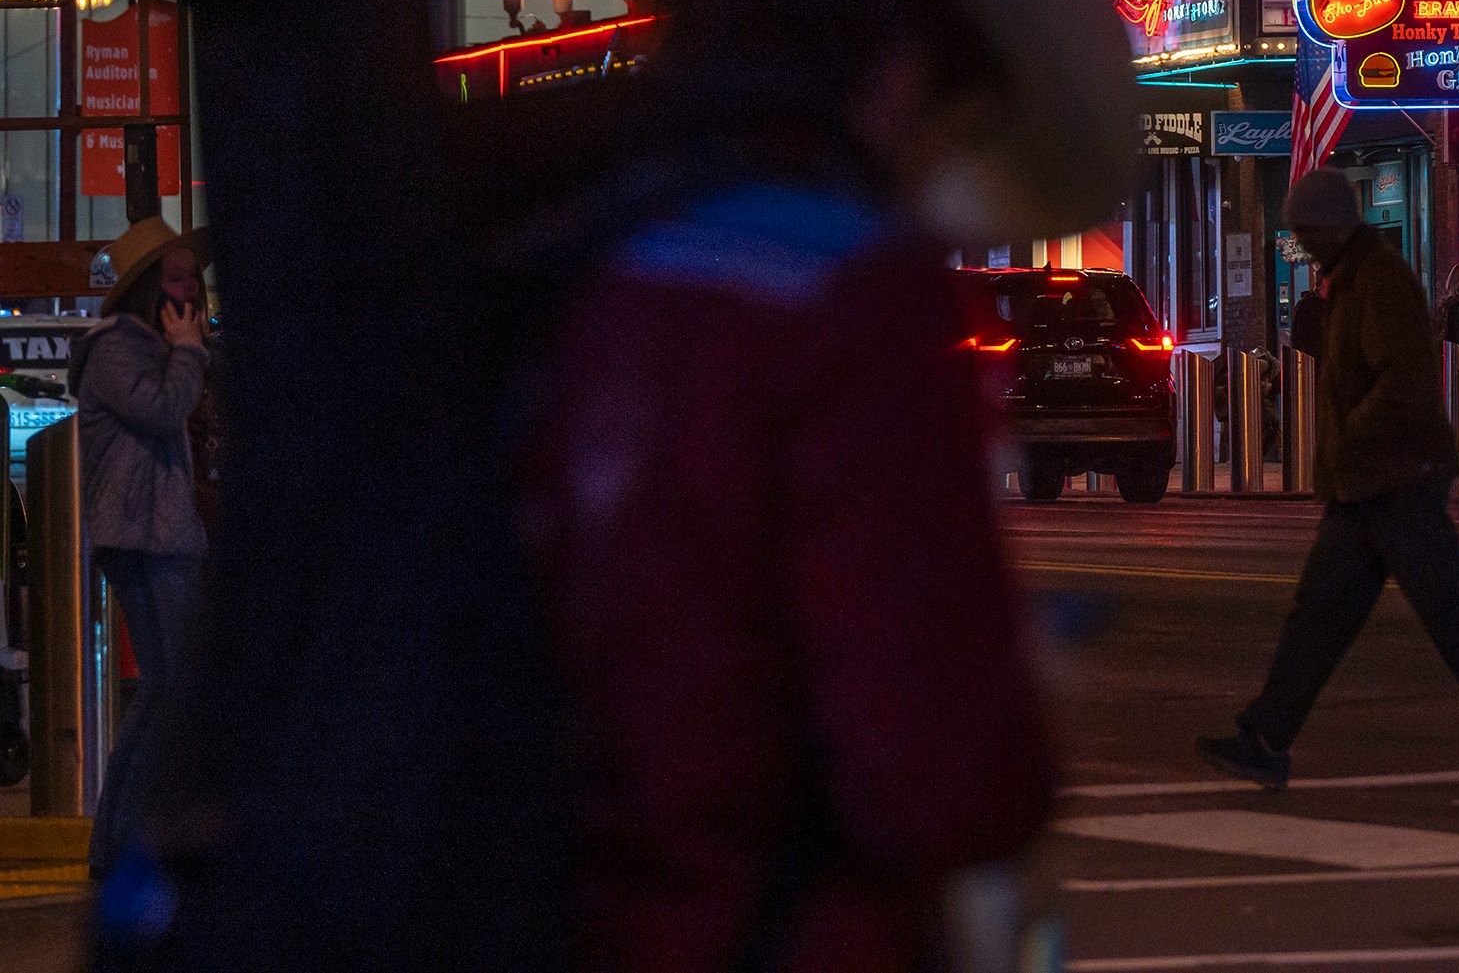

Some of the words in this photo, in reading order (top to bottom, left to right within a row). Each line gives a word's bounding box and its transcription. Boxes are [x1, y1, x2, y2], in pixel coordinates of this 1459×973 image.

[1391, 22, 1447, 45] Honky
[86, 44, 129, 62] Ryman
[85, 65, 158, 80] Auditorim
[1155, 112, 1203, 143] FIDDLE
[100, 134, 124, 149] Mus
[1160, 147, 1179, 155] MUSIC
